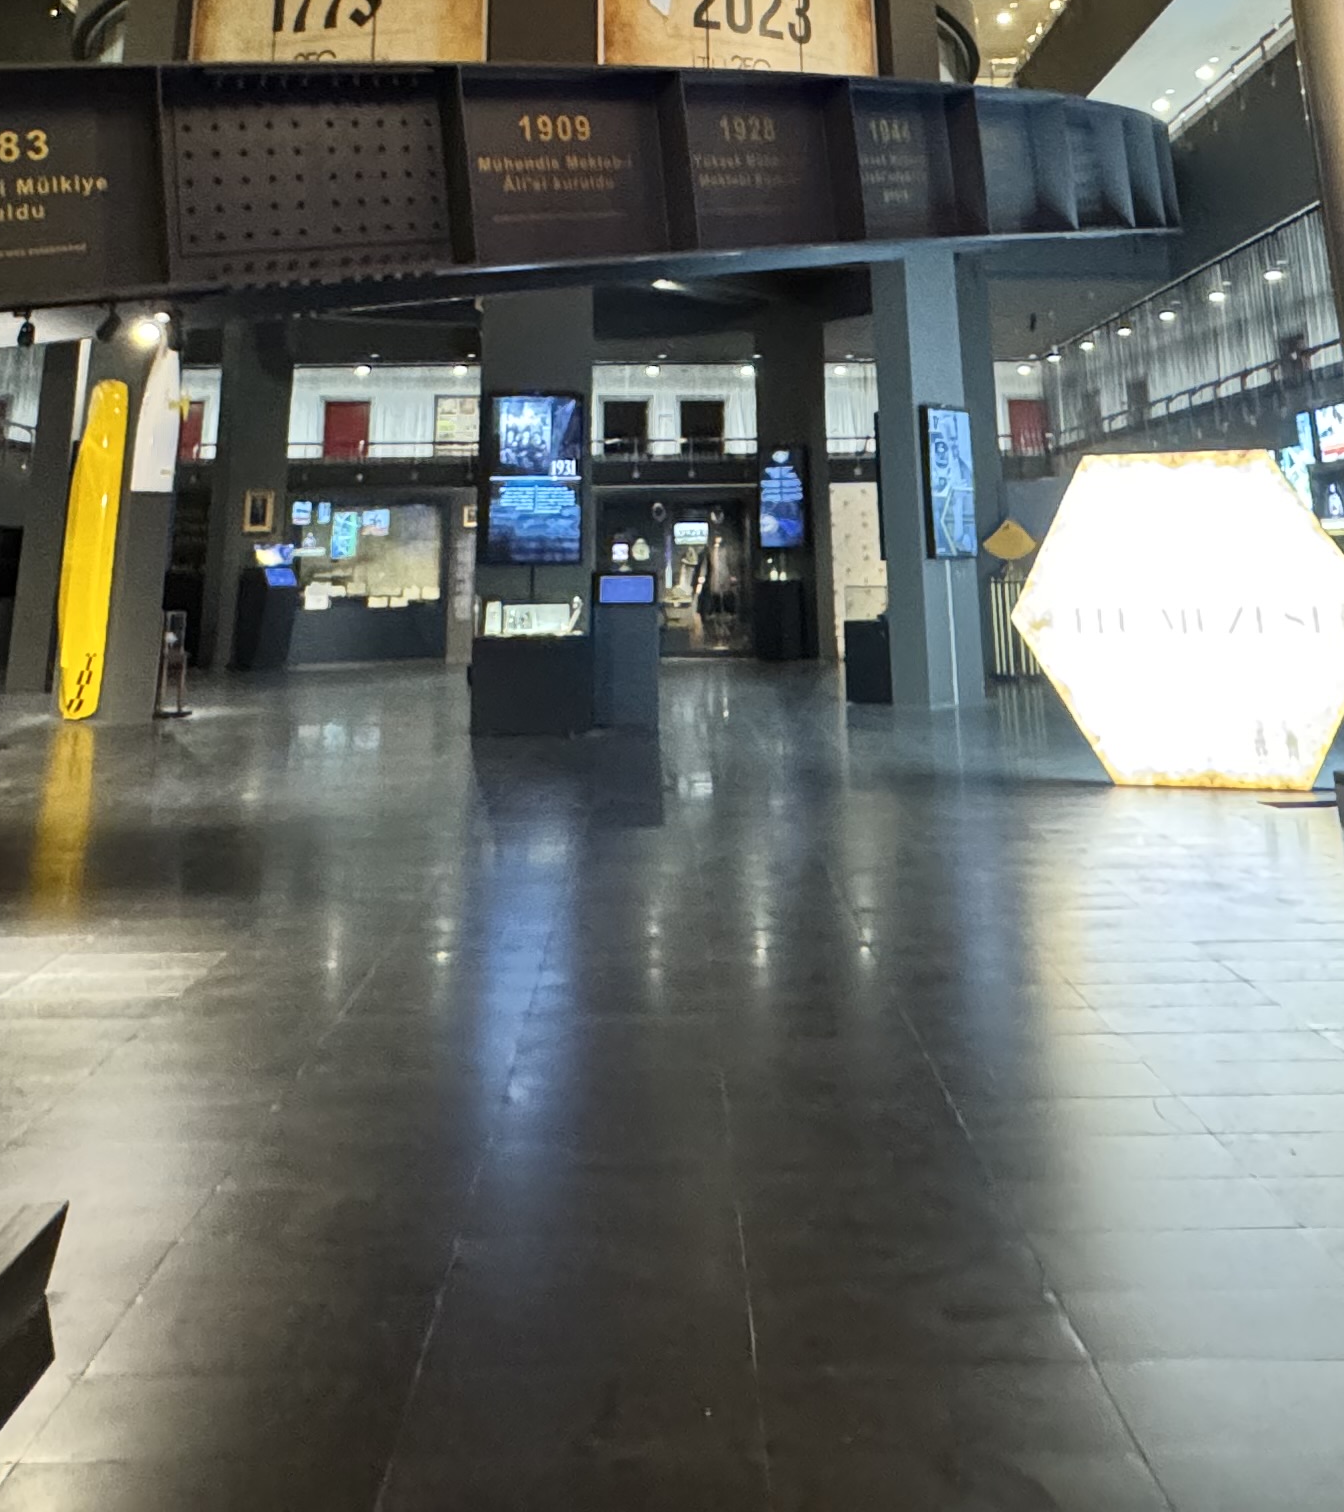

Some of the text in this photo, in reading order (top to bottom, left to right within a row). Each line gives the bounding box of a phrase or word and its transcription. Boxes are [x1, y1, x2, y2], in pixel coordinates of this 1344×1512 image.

[518, 114, 591, 142] 1909
[15, 173, 110, 198] Mülkiye
[550, 458, 577, 476] 1931
